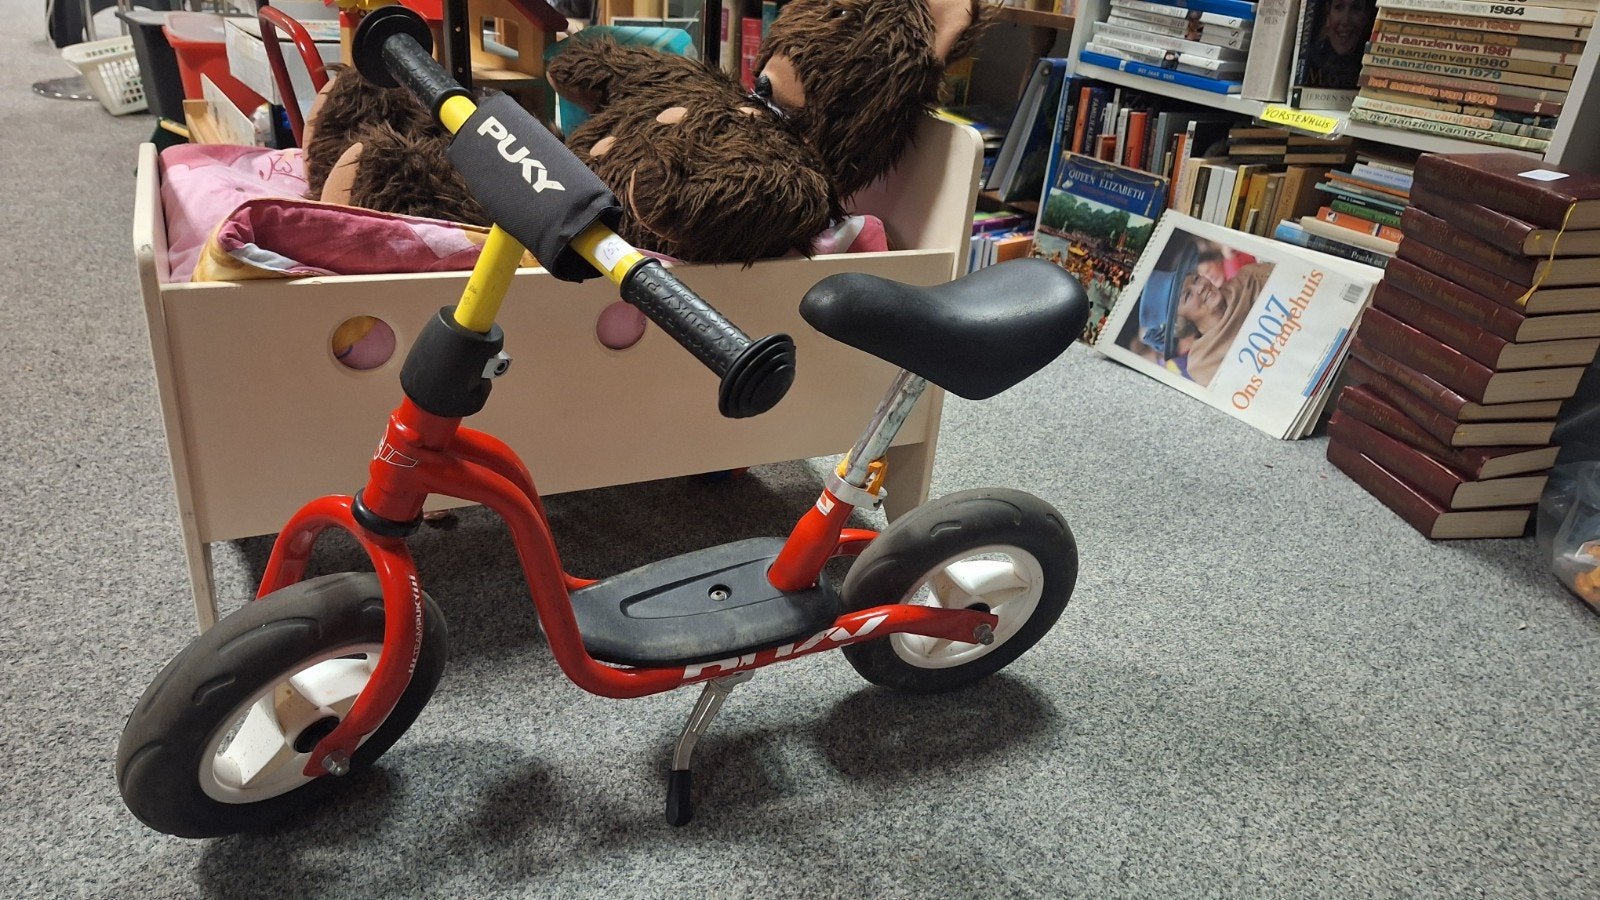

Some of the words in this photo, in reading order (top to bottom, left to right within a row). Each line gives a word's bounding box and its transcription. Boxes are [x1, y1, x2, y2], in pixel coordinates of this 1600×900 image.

[1489, 4, 1525, 16] 1984
[1376, 45, 1391, 55] het
[1392, 46, 1448, 62] aanzien
[1450, 54, 1474, 66] van
[1474, 56, 1510, 69] 1980
[1381, 33, 1400, 44] het
[1401, 36, 1453, 50] aanzien
[1455, 43, 1479, 54] van
[1483, 44, 1513, 57] 1981
[1371, 55, 1391, 66] het
[1392, 57, 1442, 72] aanzien
[1444, 65, 1468, 76] van
[1469, 66, 1502, 79] 1979
[1264, 107, 1331, 129] VORSTENHUIS
[1364, 99, 1382, 110] het
[1382, 103, 1432, 118] aanzien
[1434, 113, 1458, 124] van
[1369, 112, 1388, 124] het
[1389, 116, 1438, 131] aanzien
[1439, 123, 1462, 135] van
[1463, 127, 1495, 140] 1972
[477, 115, 566, 194] PUKY
[1068, 169, 1096, 185] QUEEN
[1099, 175, 1146, 200] ELIZABETH
[1350, 249, 1374, 264] Pracht
[1373, 258, 1384, 267] en
[1231, 374, 1263, 411] Ons
[1256, 268, 1325, 369] Oranjehuis
[1238, 294, 1292, 374] 2007
